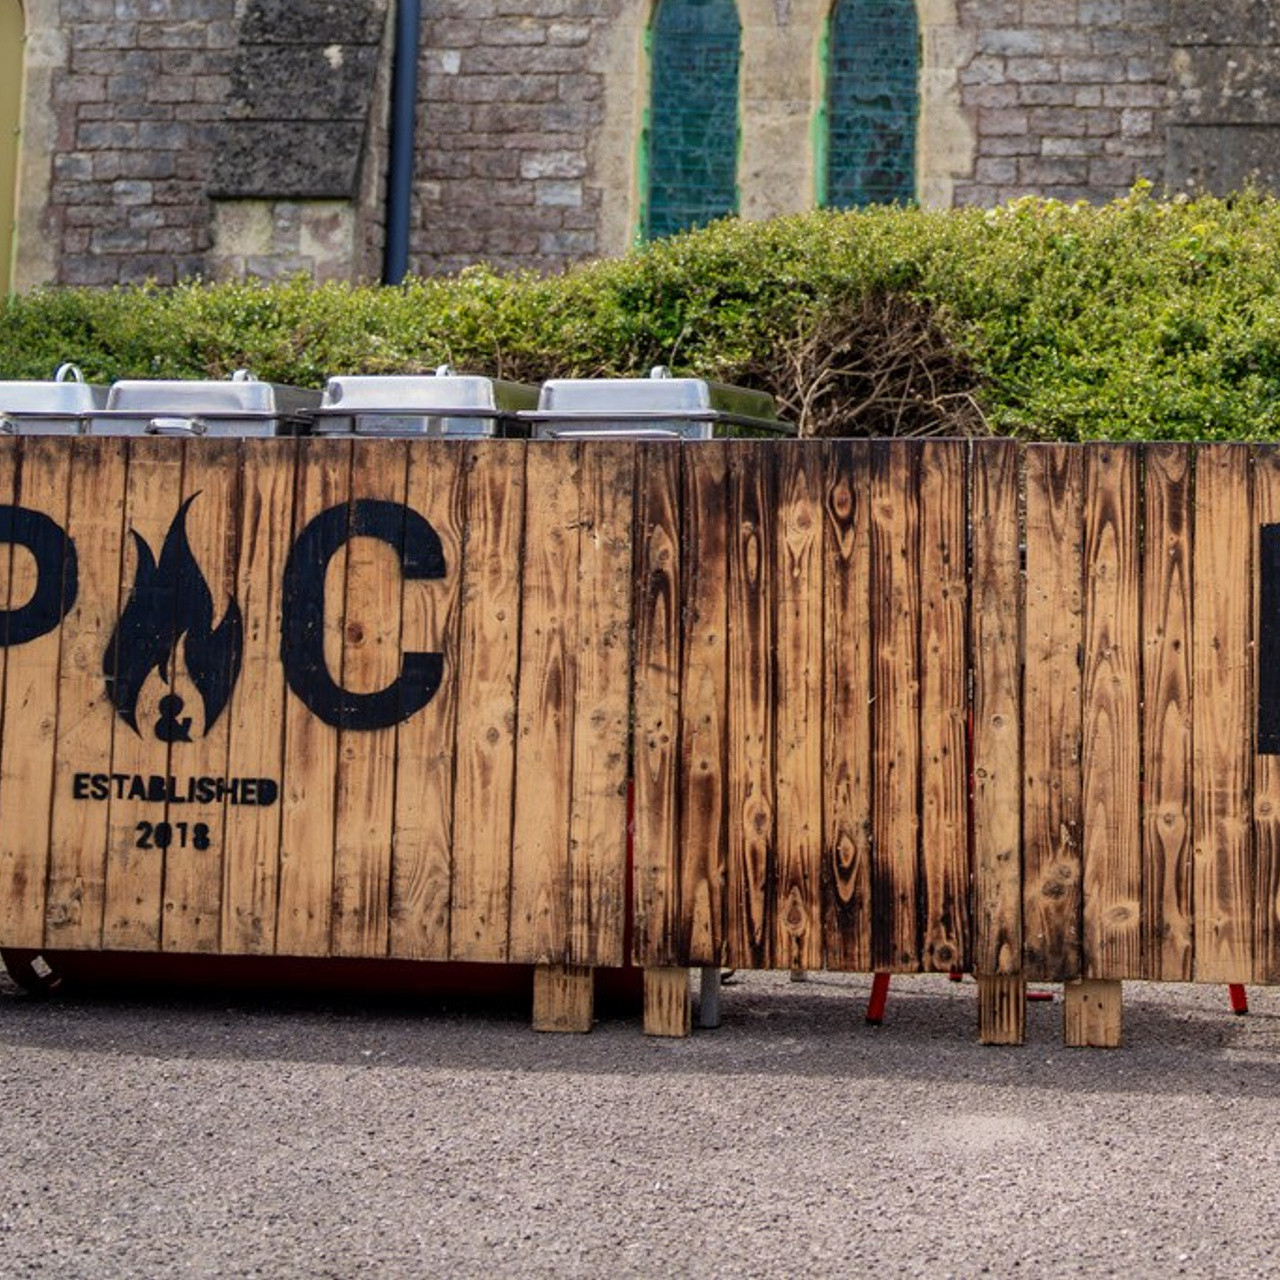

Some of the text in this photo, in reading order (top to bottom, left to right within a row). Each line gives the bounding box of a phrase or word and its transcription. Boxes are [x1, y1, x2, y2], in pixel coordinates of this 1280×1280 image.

[154, 498, 446, 742] & C
[72, 773, 279, 806] ESTABLISHED
[136, 821, 211, 850] 2018
